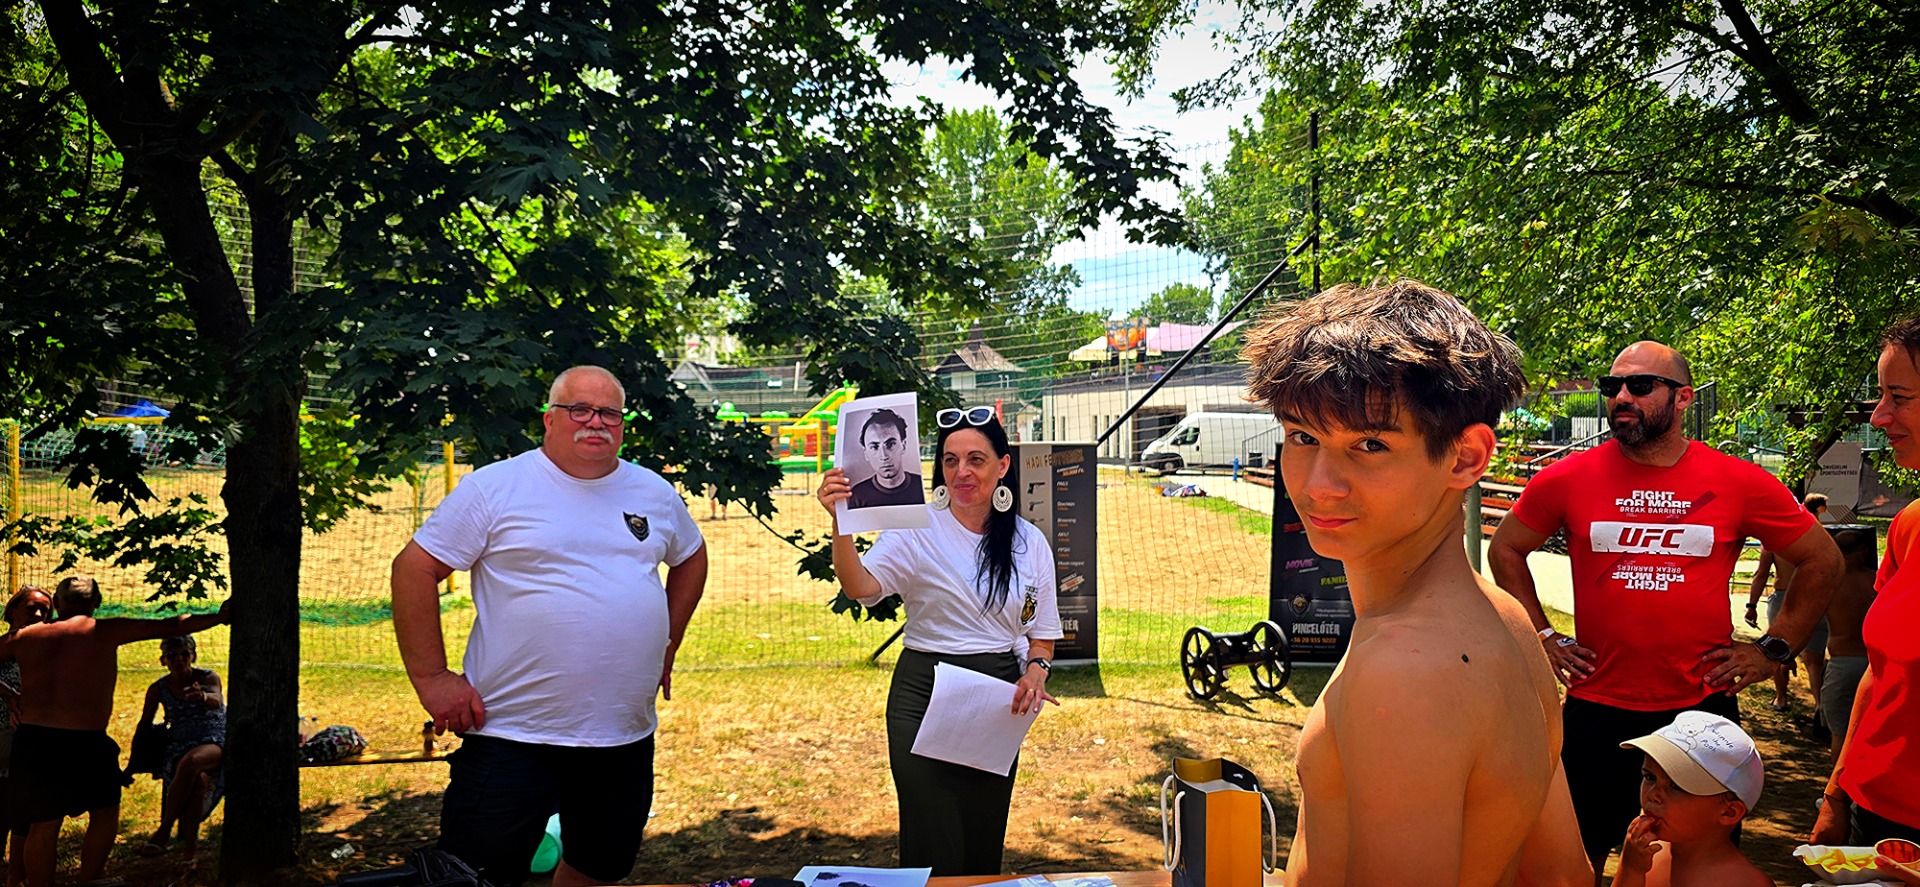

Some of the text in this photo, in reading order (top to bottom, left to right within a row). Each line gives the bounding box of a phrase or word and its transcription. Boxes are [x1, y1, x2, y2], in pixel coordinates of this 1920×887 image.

[1632, 490, 1675, 501] FIGHT
[1615, 498, 1691, 509] FOR MORE
[1618, 527, 1685, 549] UFC
[1617, 564, 1653, 572] BARRIERS
[1656, 573, 1685, 582] FOR
[1625, 580, 1669, 591] FIGHT
